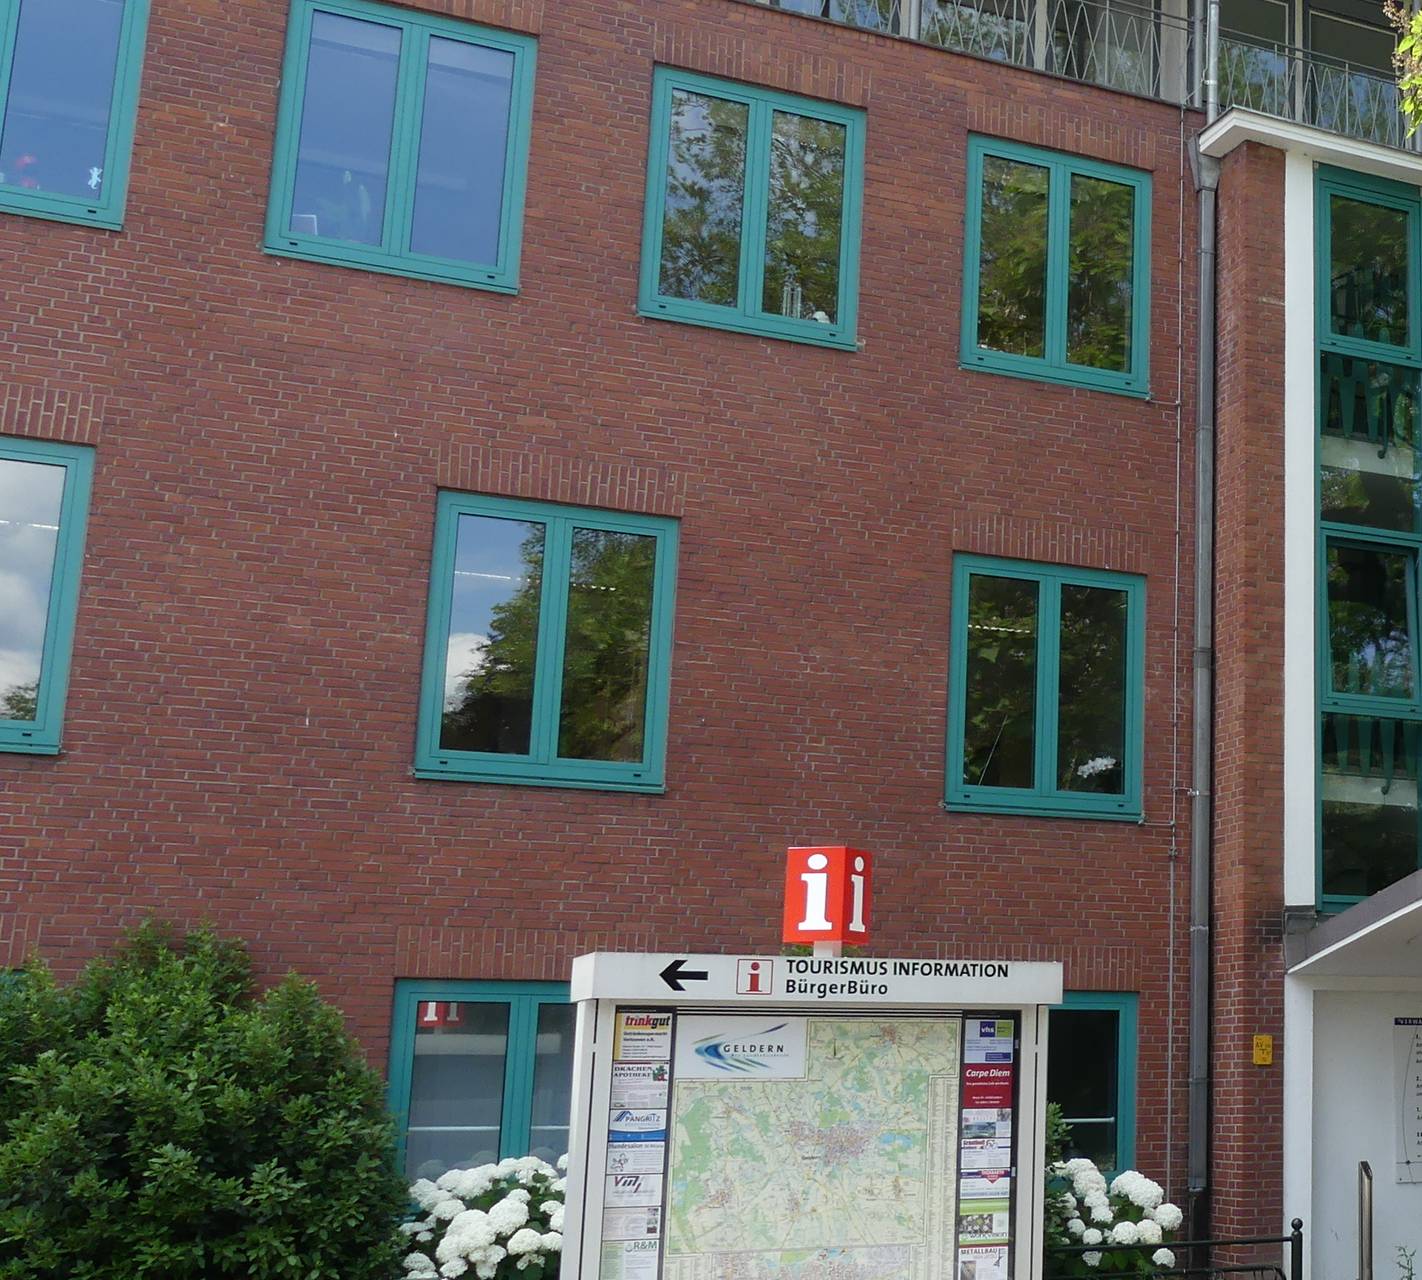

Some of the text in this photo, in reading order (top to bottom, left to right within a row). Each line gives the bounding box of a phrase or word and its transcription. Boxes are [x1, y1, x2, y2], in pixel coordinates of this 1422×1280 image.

[797, 853, 833, 931] i
[849, 856, 866, 933] i
[786, 959, 1009, 978] TOURISMUS INFORMATION
[785, 979, 889, 998] BürgerBüro
[625, 1015, 671, 1029] trinkgut
[723, 1044, 785, 1053] GELDERN
[966, 1069, 1010, 1078] Carpe Diem
[633, 1241, 657, 1250] R&M
